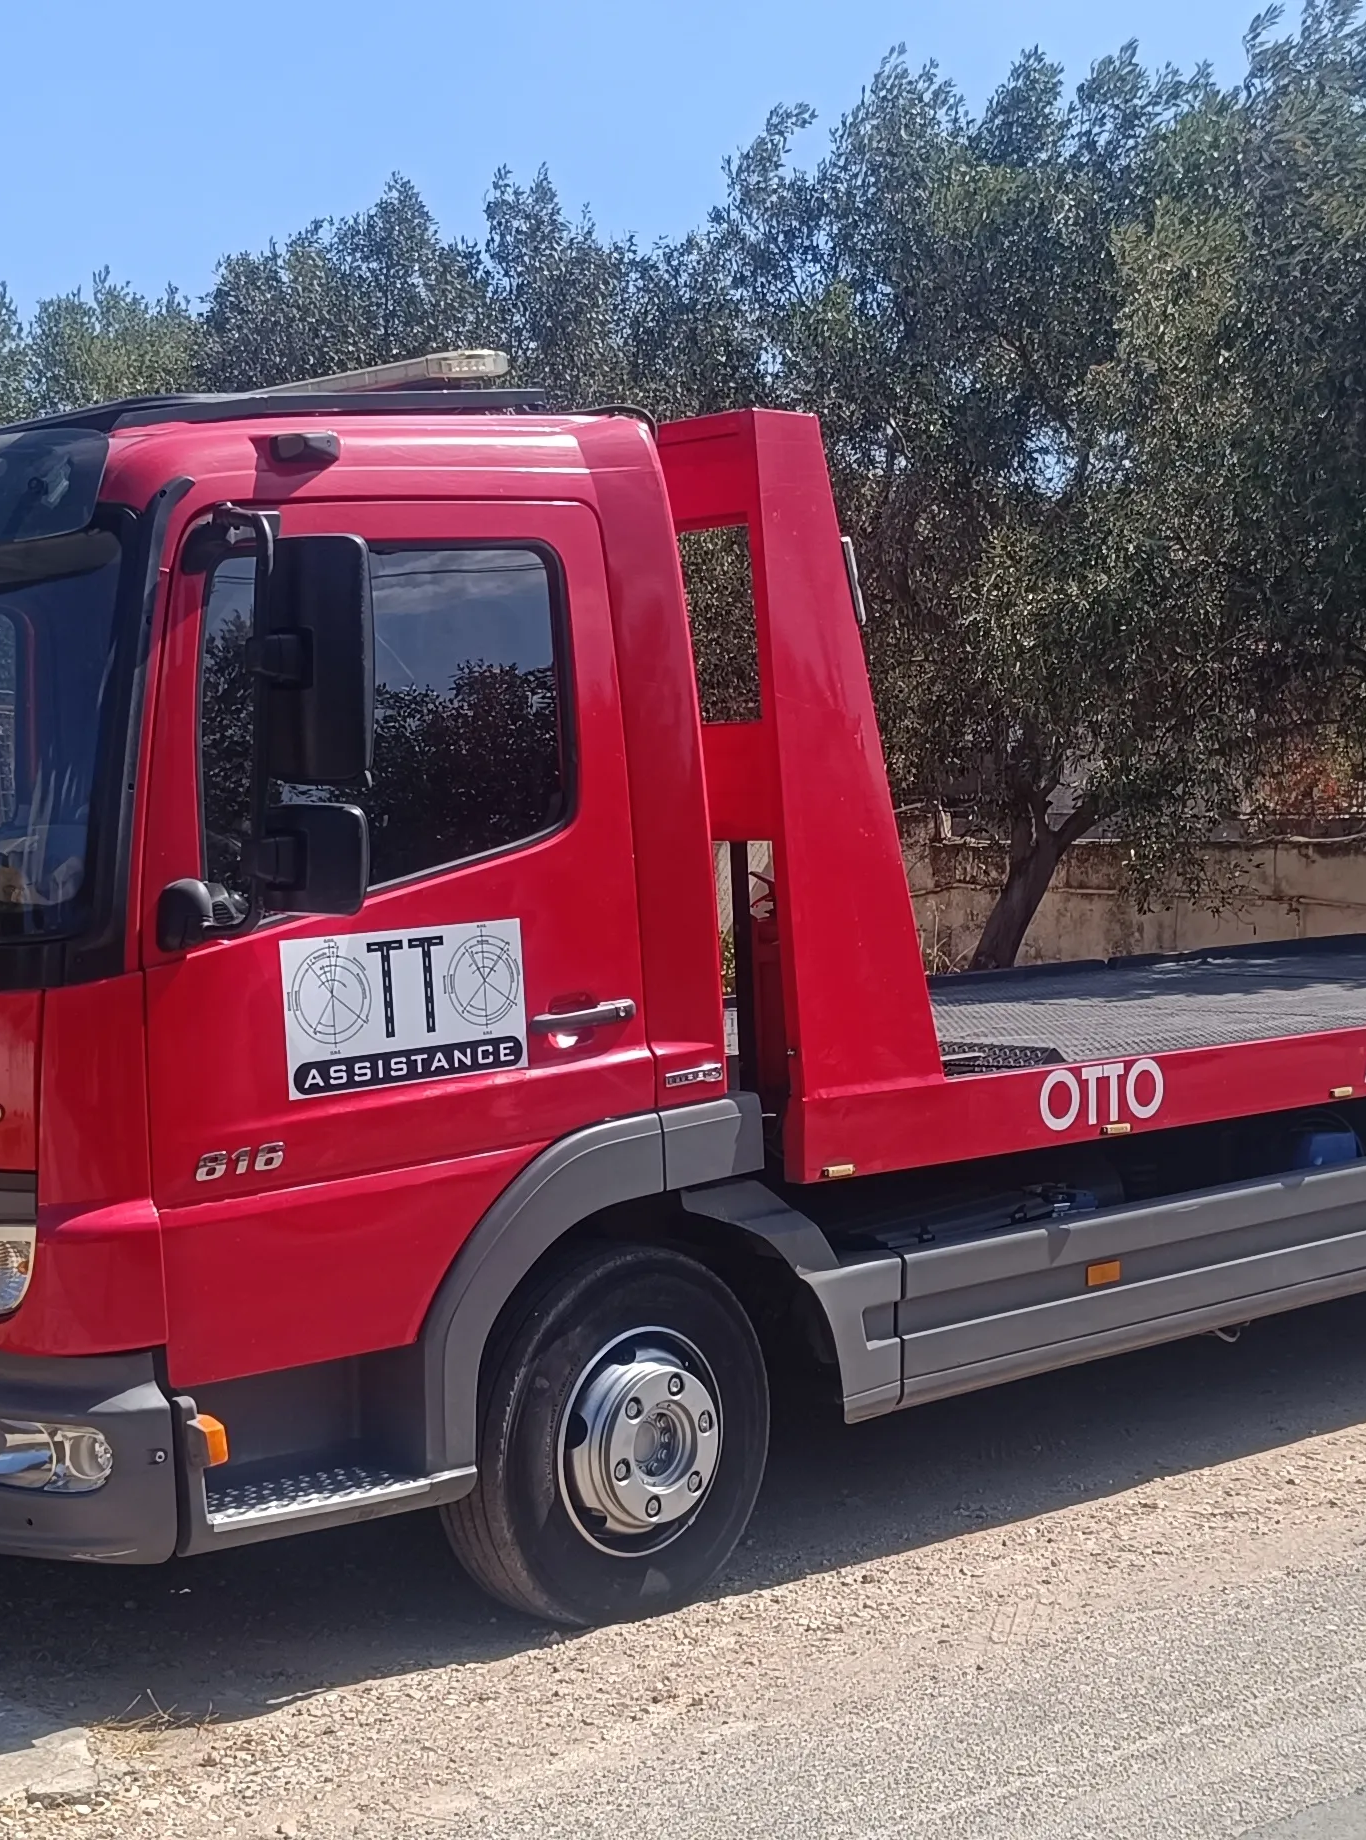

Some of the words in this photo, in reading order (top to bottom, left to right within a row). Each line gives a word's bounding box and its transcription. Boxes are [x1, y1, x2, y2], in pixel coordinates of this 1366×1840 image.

[305, 1043, 514, 1088] ASSISTANCE
[1039, 1059, 1164, 1131] OTTO
[195, 1141, 285, 1182] 816
